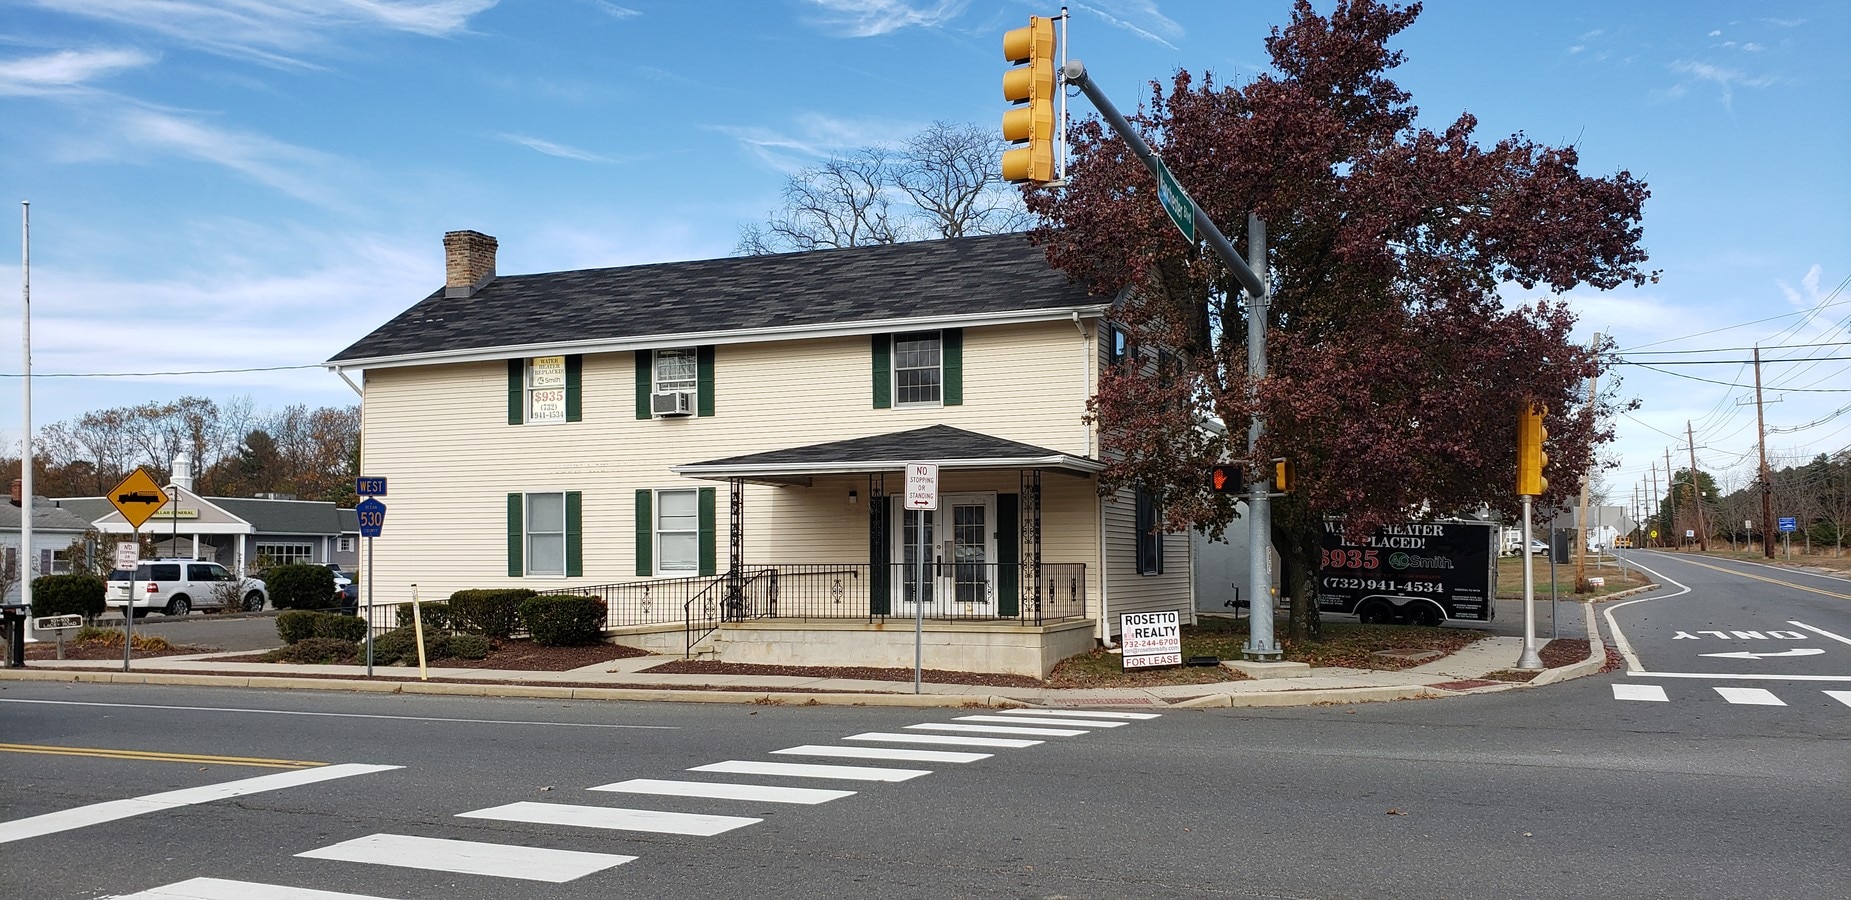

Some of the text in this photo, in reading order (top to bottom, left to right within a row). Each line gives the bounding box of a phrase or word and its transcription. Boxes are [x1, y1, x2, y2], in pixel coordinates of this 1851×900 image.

[535, 391, 564, 403] $935
[534, 411, 564, 419] 941-4534
[916, 466, 928, 476] NO
[360, 481, 382, 492] WEST
[360, 511, 382, 527] 530
[1383, 524, 1444, 536] HEATER
[1320, 548, 1379, 570] $935
[1409, 555, 1452, 569] Smith
[1125, 613, 1176, 625] ROSETTO
[1135, 626, 1177, 639] REALTY
[1672, 630, 1809, 640] ONLY
[1124, 638, 1178, 648] 732-244-6700
[1126, 655, 1180, 666] FOR LEASE
